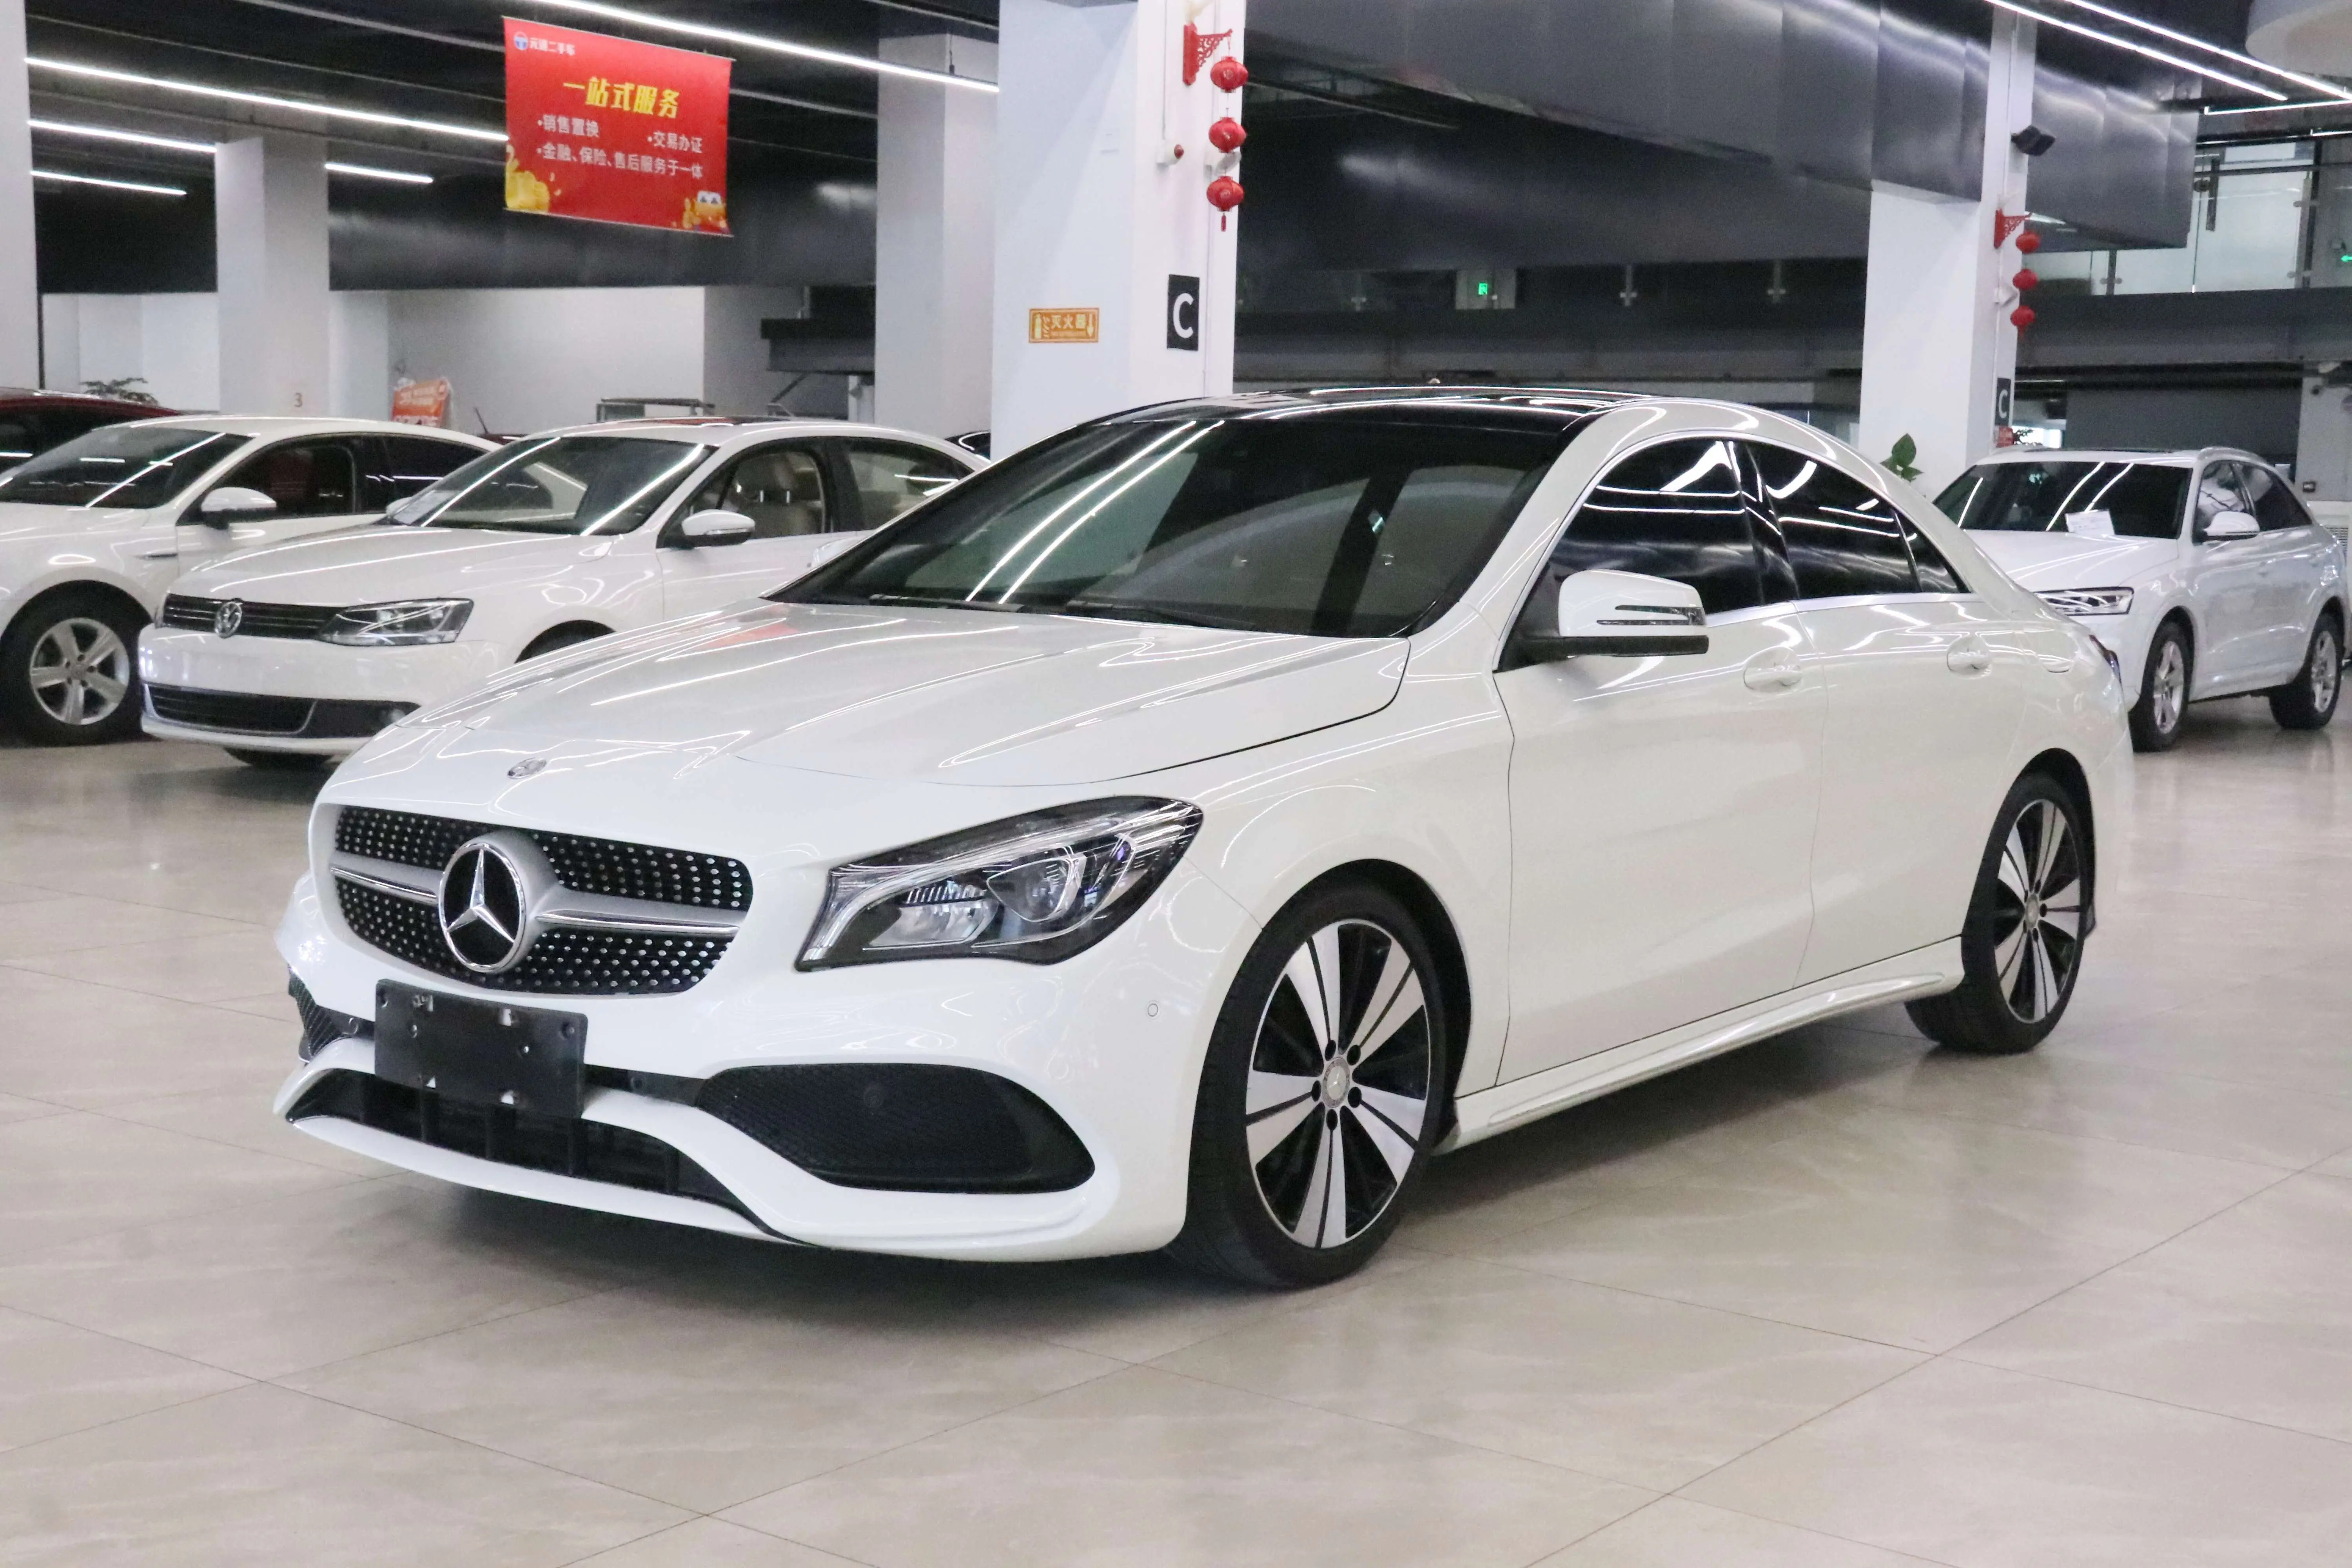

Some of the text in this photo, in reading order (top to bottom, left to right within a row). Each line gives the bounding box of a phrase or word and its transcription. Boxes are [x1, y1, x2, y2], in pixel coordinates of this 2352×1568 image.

[563, 76, 680, 118] 一站式服务
[543, 114, 599, 138] 销售置换
[653, 131, 702, 154] 交易办证
[1173, 293, 1194, 338] C
[294, 392, 303, 408] 3
[1999, 389, 2008, 418] C
